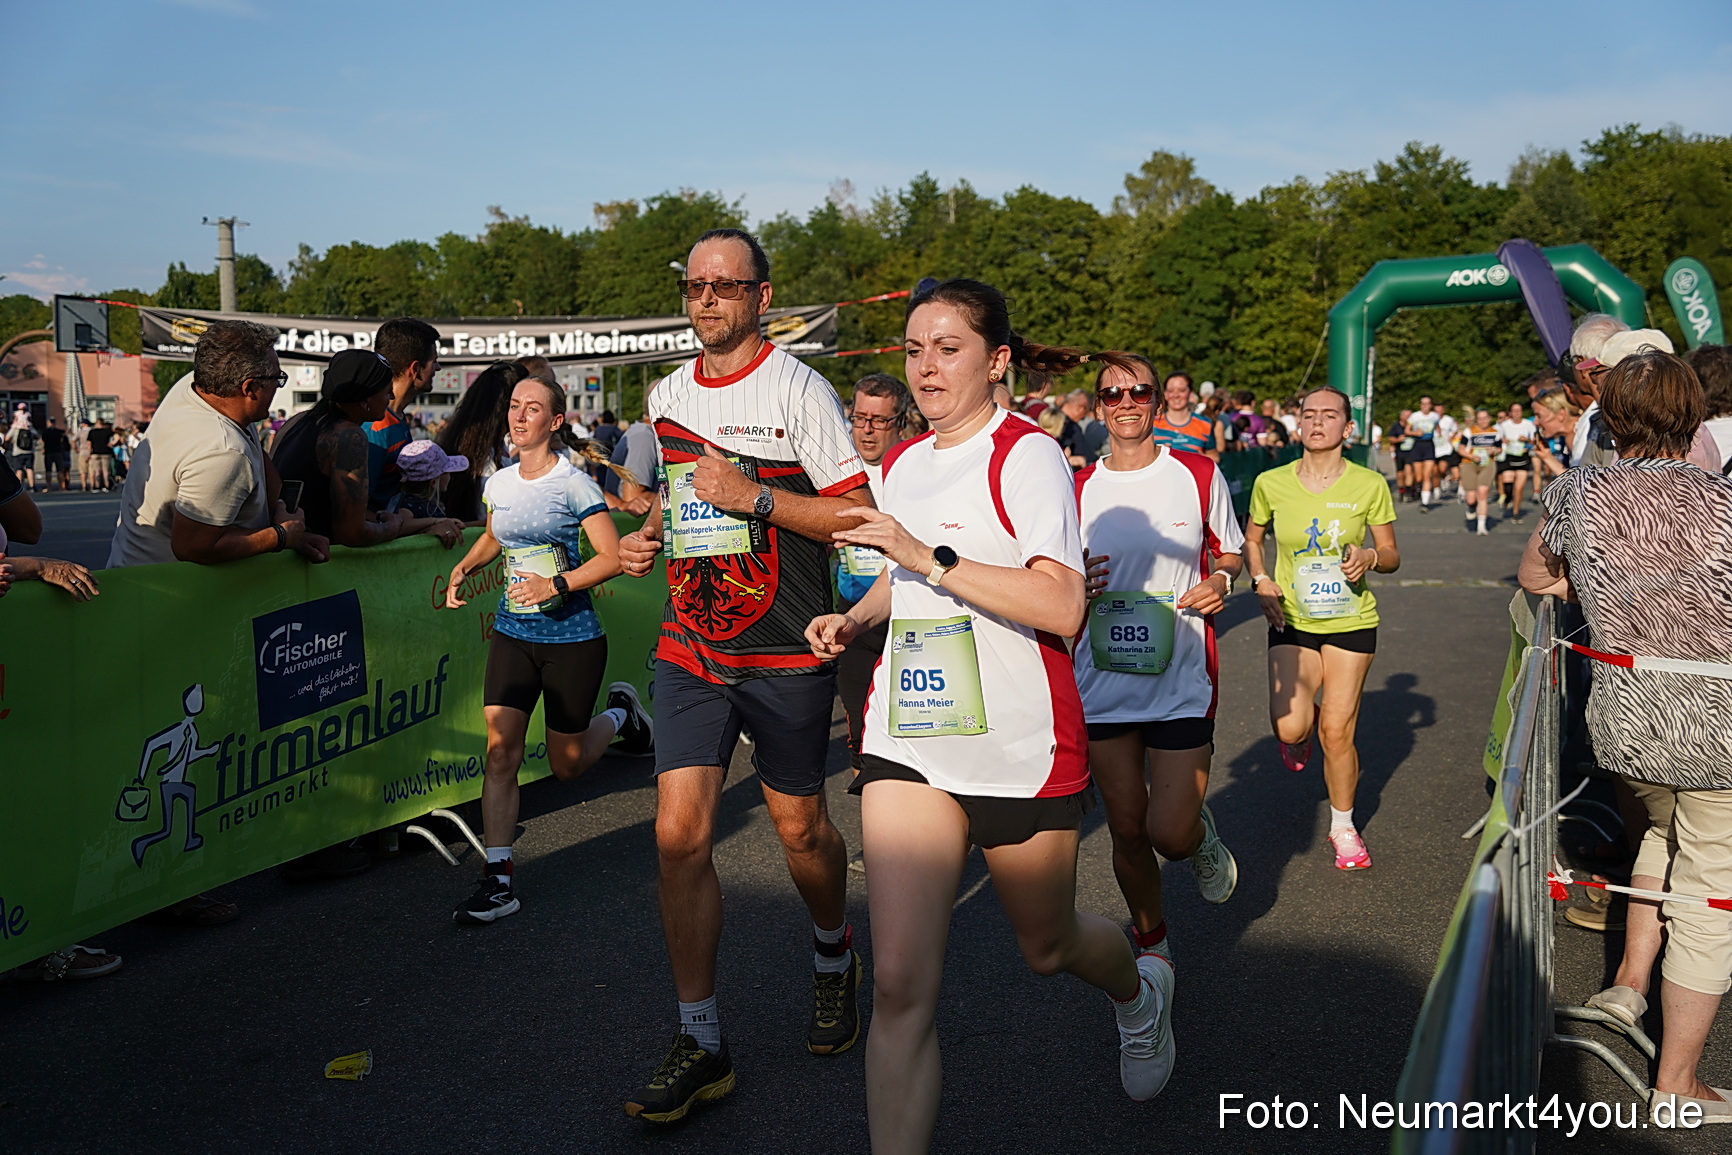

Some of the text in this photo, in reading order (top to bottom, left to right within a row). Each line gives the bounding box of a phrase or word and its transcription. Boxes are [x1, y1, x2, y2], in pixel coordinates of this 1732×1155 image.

[1446, 268, 1487, 288] AOK
[1682, 289, 1712, 341] AOK
[273, 327, 299, 351] uf
[302, 328, 349, 353] die
[454, 330, 544, 358] Fertig.
[549, 327, 704, 356] Miteinand
[717, 425, 773, 437] NEUMARKT
[672, 526, 690, 536] Michael
[1310, 582, 1341, 595] 240
[1110, 625, 1149, 642] 683
[274, 630, 348, 666] Fischer
[1107, 645, 1156, 653] Katharina Zill
[282, 649, 343, 676] AUTOMOBILE
[297, 680, 313, 696] und
[314, 674, 330, 686] das
[340, 673, 359, 688] mit!
[900, 668, 946, 692] 605
[898, 697, 955, 708] Hanna Meier
[215, 653, 450, 803] firmenlauf
[218, 766, 329, 833] neumarkt
